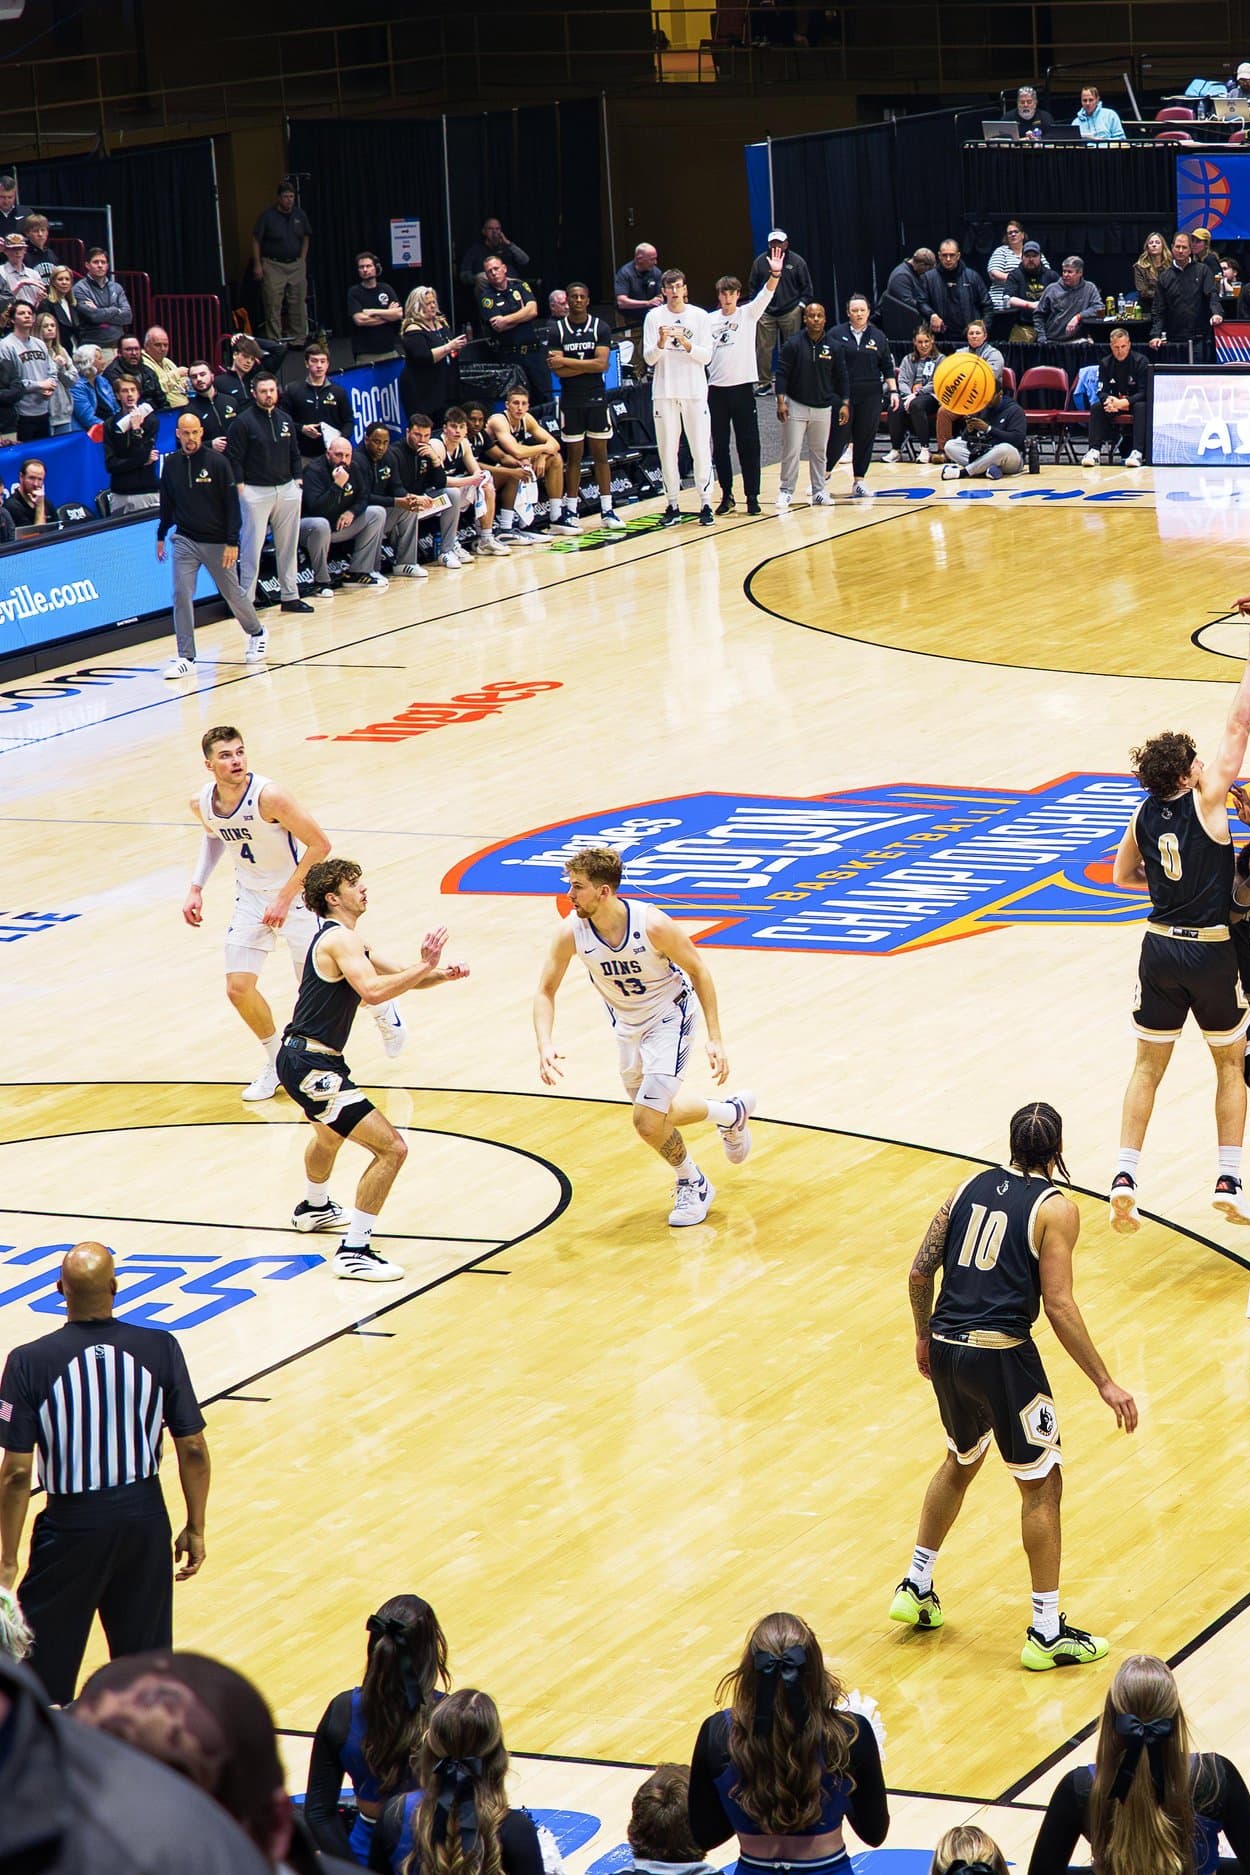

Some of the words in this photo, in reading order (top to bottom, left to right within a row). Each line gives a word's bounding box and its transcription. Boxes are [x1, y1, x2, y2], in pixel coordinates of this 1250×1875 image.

[305, 680, 564, 742] ingles
[219, 827, 252, 841] DINS
[240, 843, 256, 864] 4
[765, 808, 1009, 902] BASKETBALL
[1158, 833, 1183, 881] 0
[600, 960, 642, 976] DINS
[614, 978, 647, 996] 13
[958, 1203, 1008, 1271] 10
